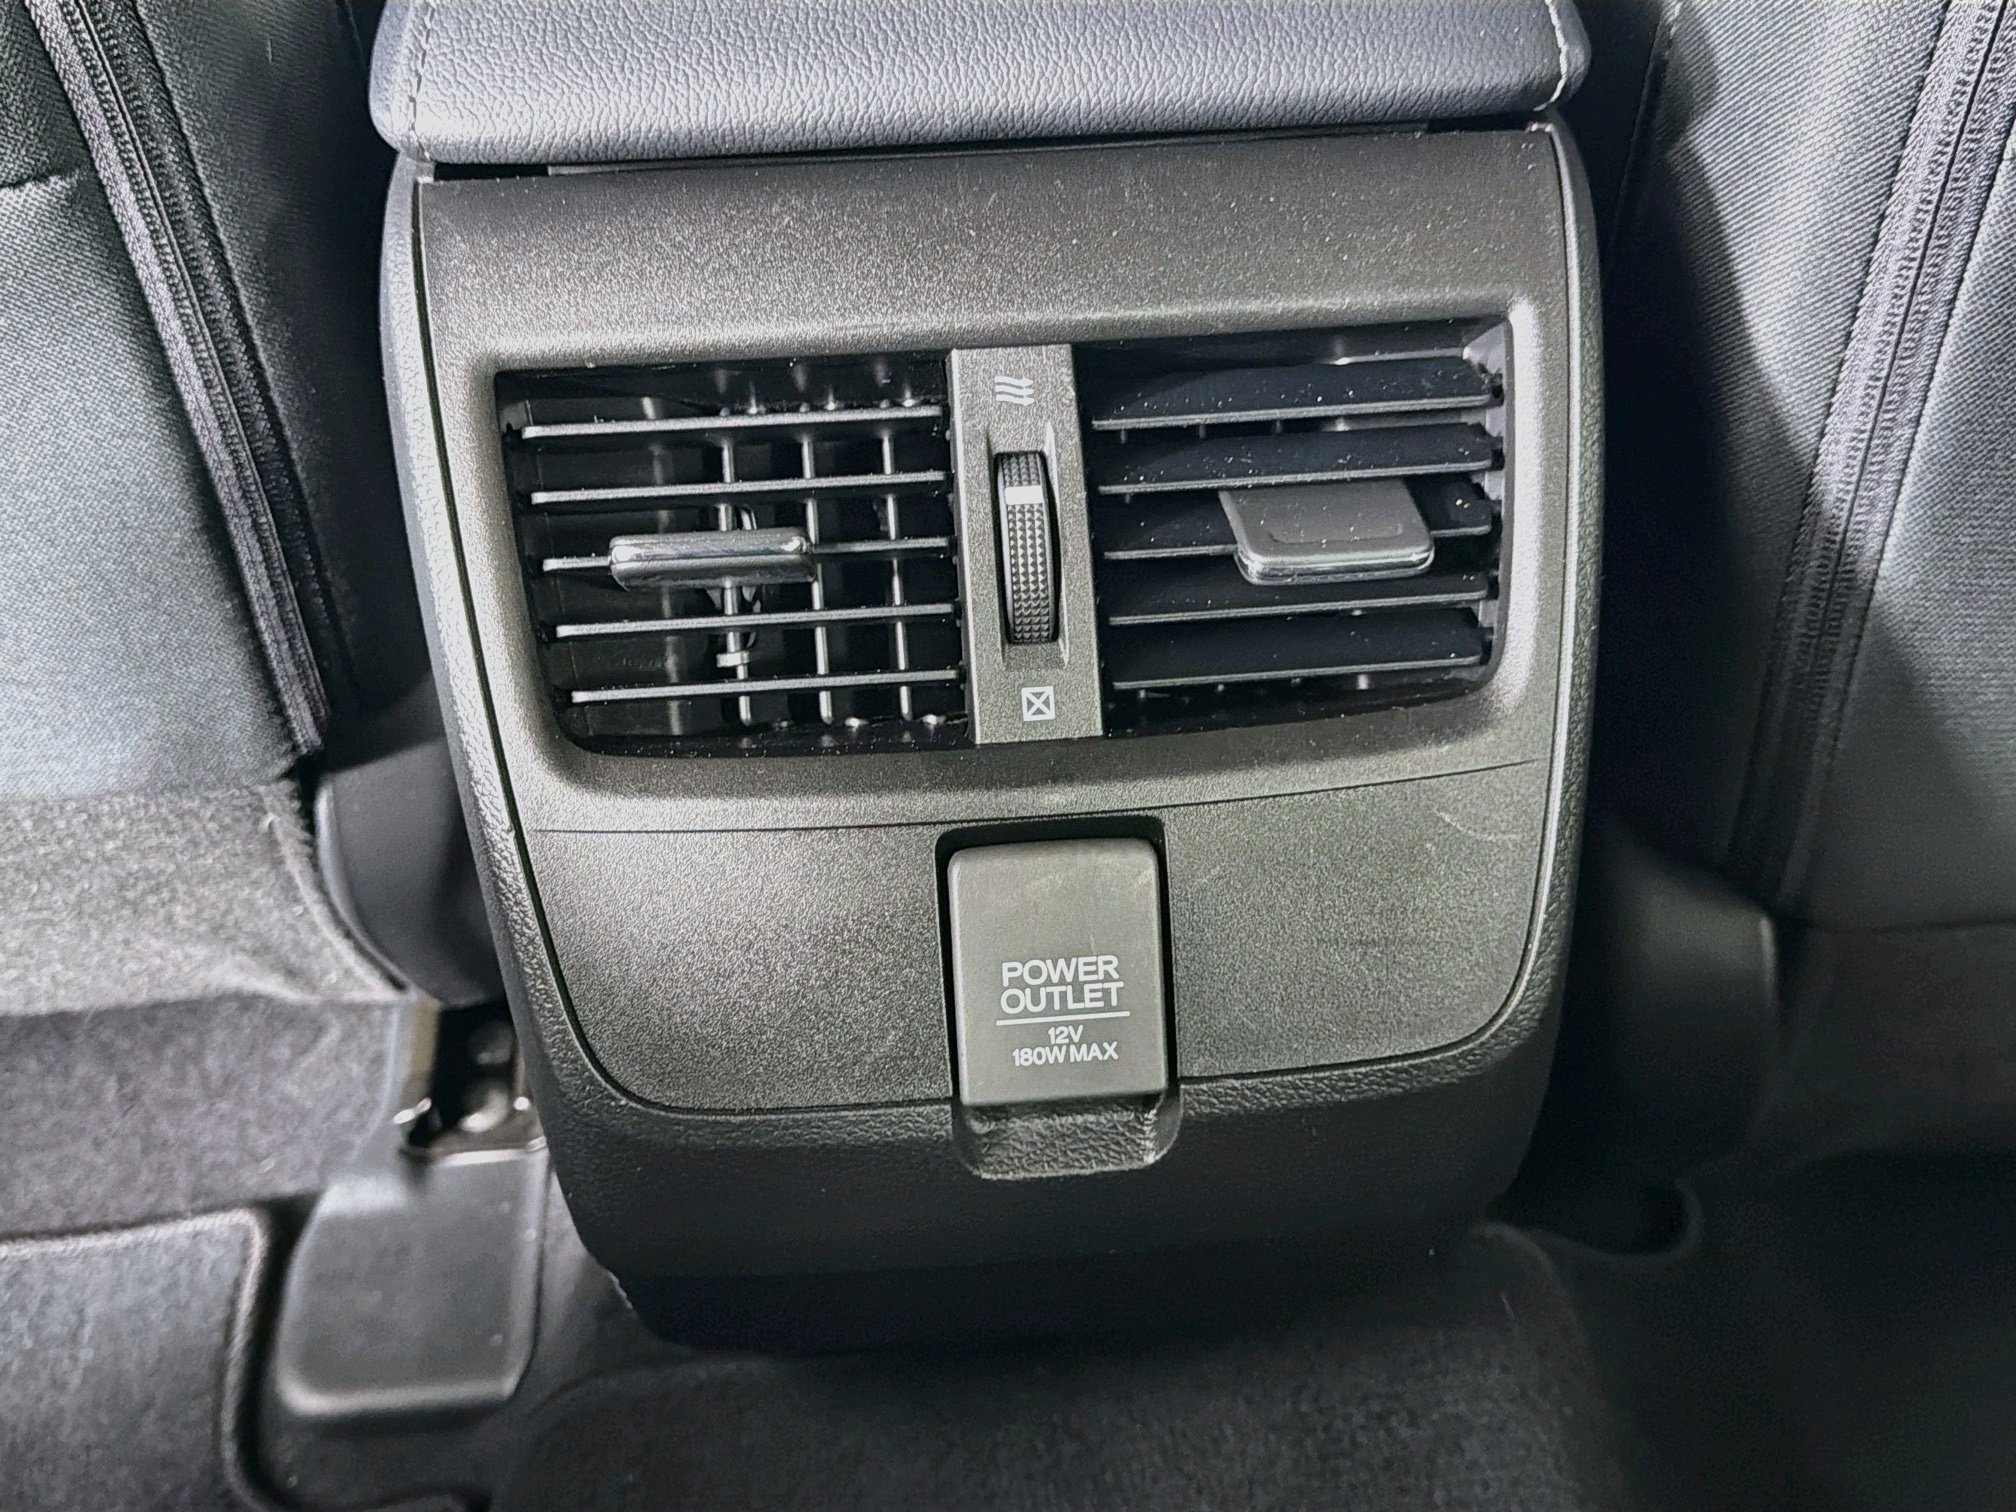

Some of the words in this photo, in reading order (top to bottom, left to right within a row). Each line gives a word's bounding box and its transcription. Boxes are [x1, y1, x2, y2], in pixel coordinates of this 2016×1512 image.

[1001, 954, 1120, 987] POWER
[1000, 981, 1125, 1014] OUTLET
[1047, 1024, 1084, 1045] 12V
[1012, 1045, 1067, 1067] 180W
[1069, 1041, 1119, 1063] MAX
